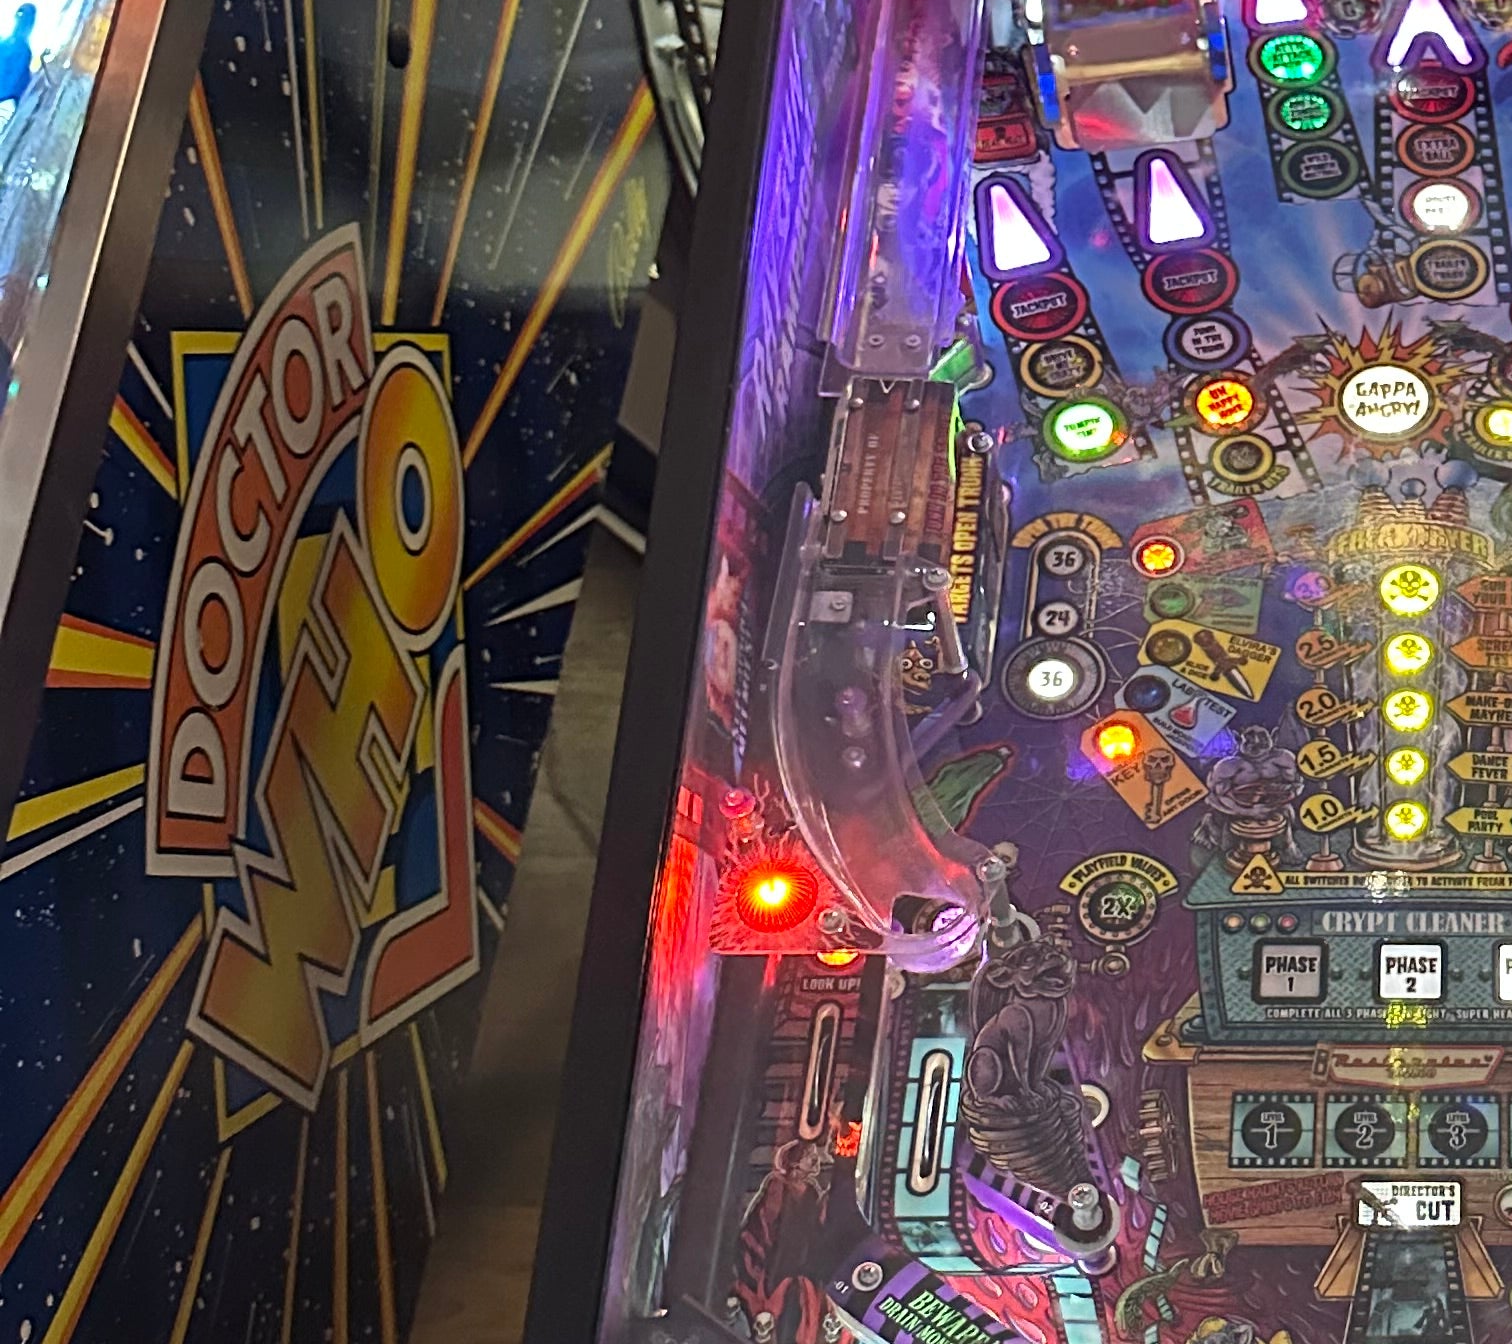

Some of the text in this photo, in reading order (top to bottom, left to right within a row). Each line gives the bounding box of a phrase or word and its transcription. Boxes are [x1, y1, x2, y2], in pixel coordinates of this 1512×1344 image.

[1163, 270, 1218, 291] JACKPOT
[1012, 292, 1068, 320] JACKPOT
[168, 274, 368, 822] DOCTOR
[950, 458, 985, 624] TARGETS OPEN TRUNK
[1052, 551, 1076, 568] 36
[1046, 610, 1071, 626] 24
[1227, 644, 1272, 664] DAGGER
[1229, 635, 1278, 657] ELVIRA'S
[1300, 637, 1336, 657] 2.5
[1041, 671, 1063, 687] 36
[1172, 678, 1233, 719] LAB TEST
[1299, 694, 1338, 717] 2.0
[186, 342, 468, 1112] WHO
[1300, 747, 1336, 771] 1.5
[1472, 754, 1509, 767] DANCE
[1110, 764, 1142, 787] KEY
[1472, 766, 1509, 780] FEVER
[1304, 800, 1340, 826] 1.0
[1474, 809, 1499, 821] POOL
[1468, 819, 1503, 833] PARTY
[1075, 854, 1168, 886] PLAYFIELD VALUES
[1285, 875, 1302, 886] ALL
[1303, 876, 1350, 887] SWITCHES
[1101, 895, 1136, 918] 2X
[1321, 911, 1505, 935] CRYPT CLEANER
[1264, 955, 1319, 975] PHASE
[1385, 955, 1439, 976] PHASE
[803, 978, 830, 992] LOOK
[1286, 977, 1294, 992] 1
[1405, 977, 1417, 993] 2
[1265, 1008, 1323, 1020] COMPLETE
[1324, 1008, 1344, 1020] ALL
[1261, 1112, 1285, 1150] LEVEL 1
[1354, 1112, 1377, 1149] LEVEL 2
[1447, 1112, 1470, 1149] LEVEL 3
[1391, 1185, 1456, 1197] DIRECTOR'S
[1415, 1200, 1456, 1221] CUT
[879, 1296, 920, 1333] DRAIN
